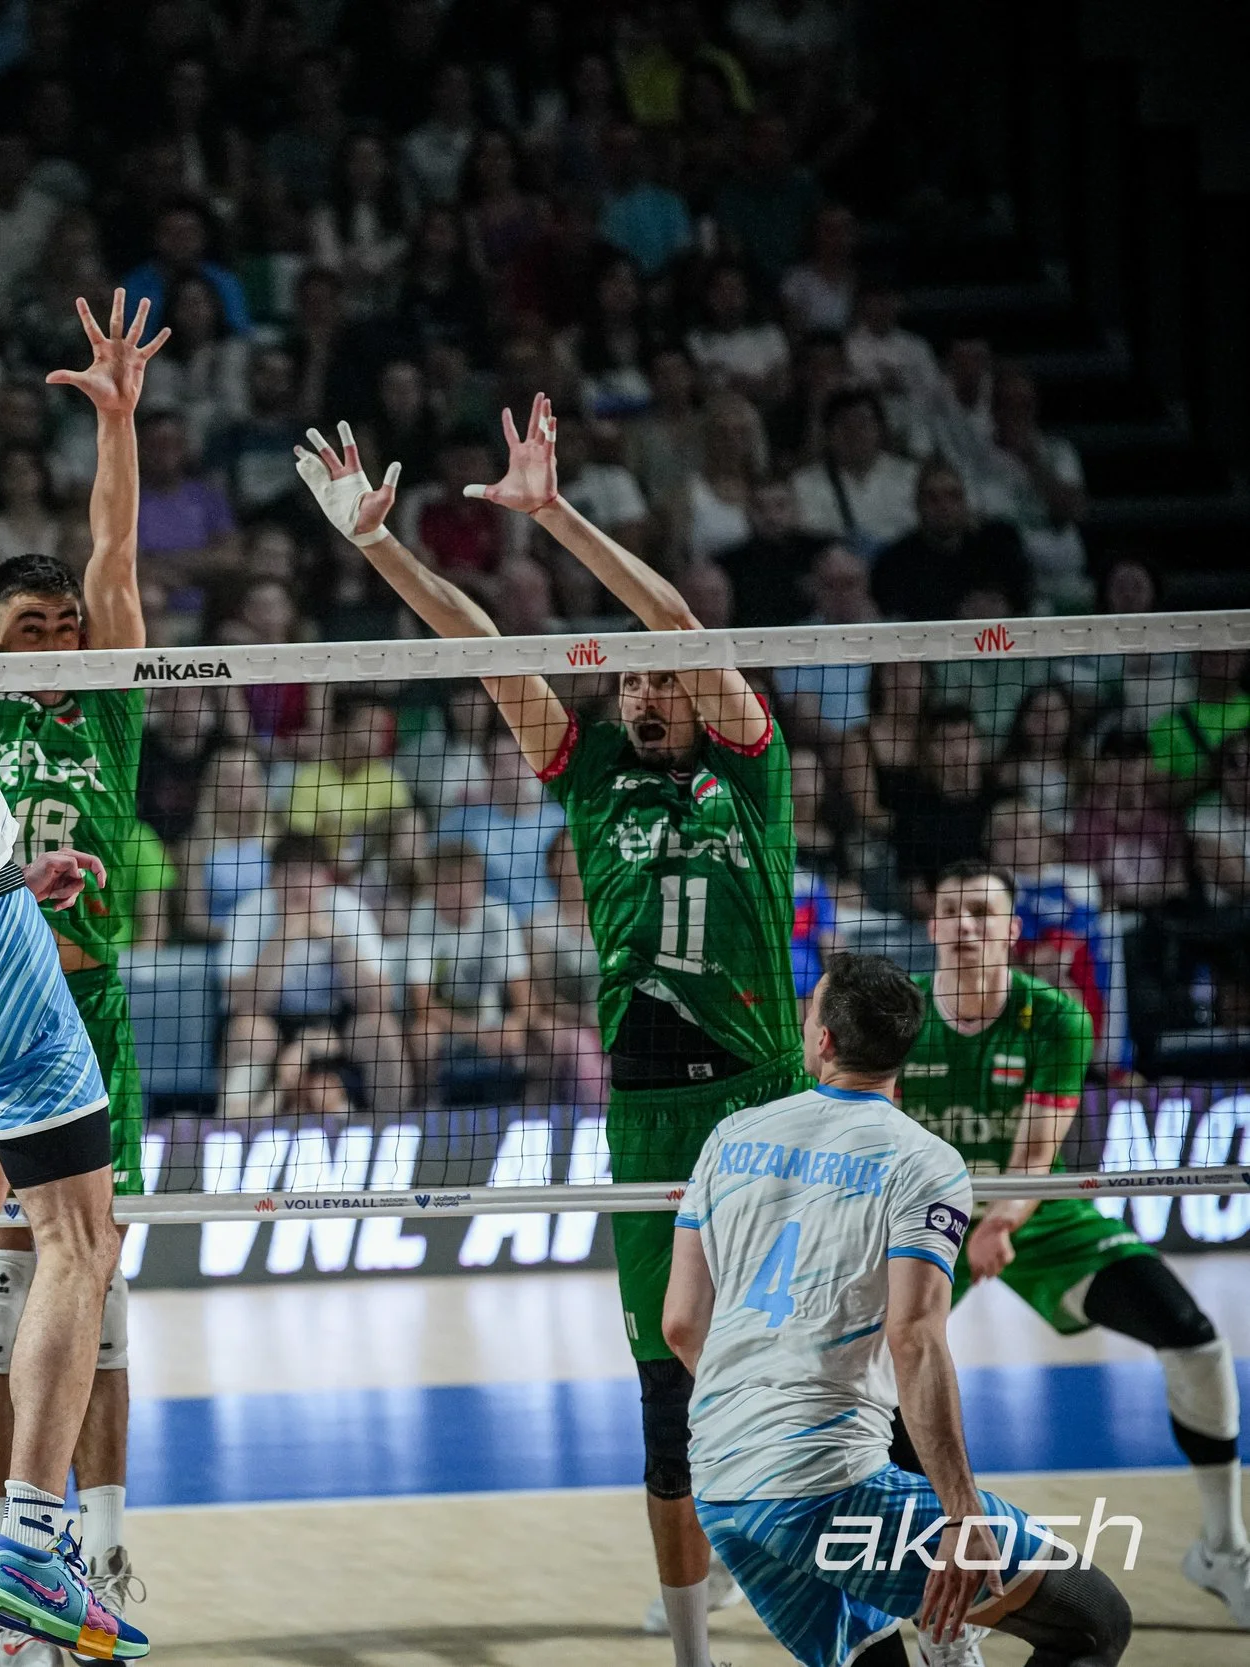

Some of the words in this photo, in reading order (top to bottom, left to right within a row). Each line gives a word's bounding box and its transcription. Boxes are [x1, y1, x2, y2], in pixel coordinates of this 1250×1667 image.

[566, 639, 607, 666] VNL
[974, 624, 1015, 652] VNL
[133, 660, 232, 682] MIKASA
[13, 797, 81, 866] 18
[655, 875, 708, 975] 11
[717, 1141, 890, 1197] KOZAMERNIK
[1108, 1175, 1201, 1187] VOLLEYBALL
[199, 1121, 427, 1277] VNL
[254, 1197, 278, 1213] VNL
[284, 1199, 377, 1210] VOLLEYBALL
[744, 1221, 801, 1328] 4
